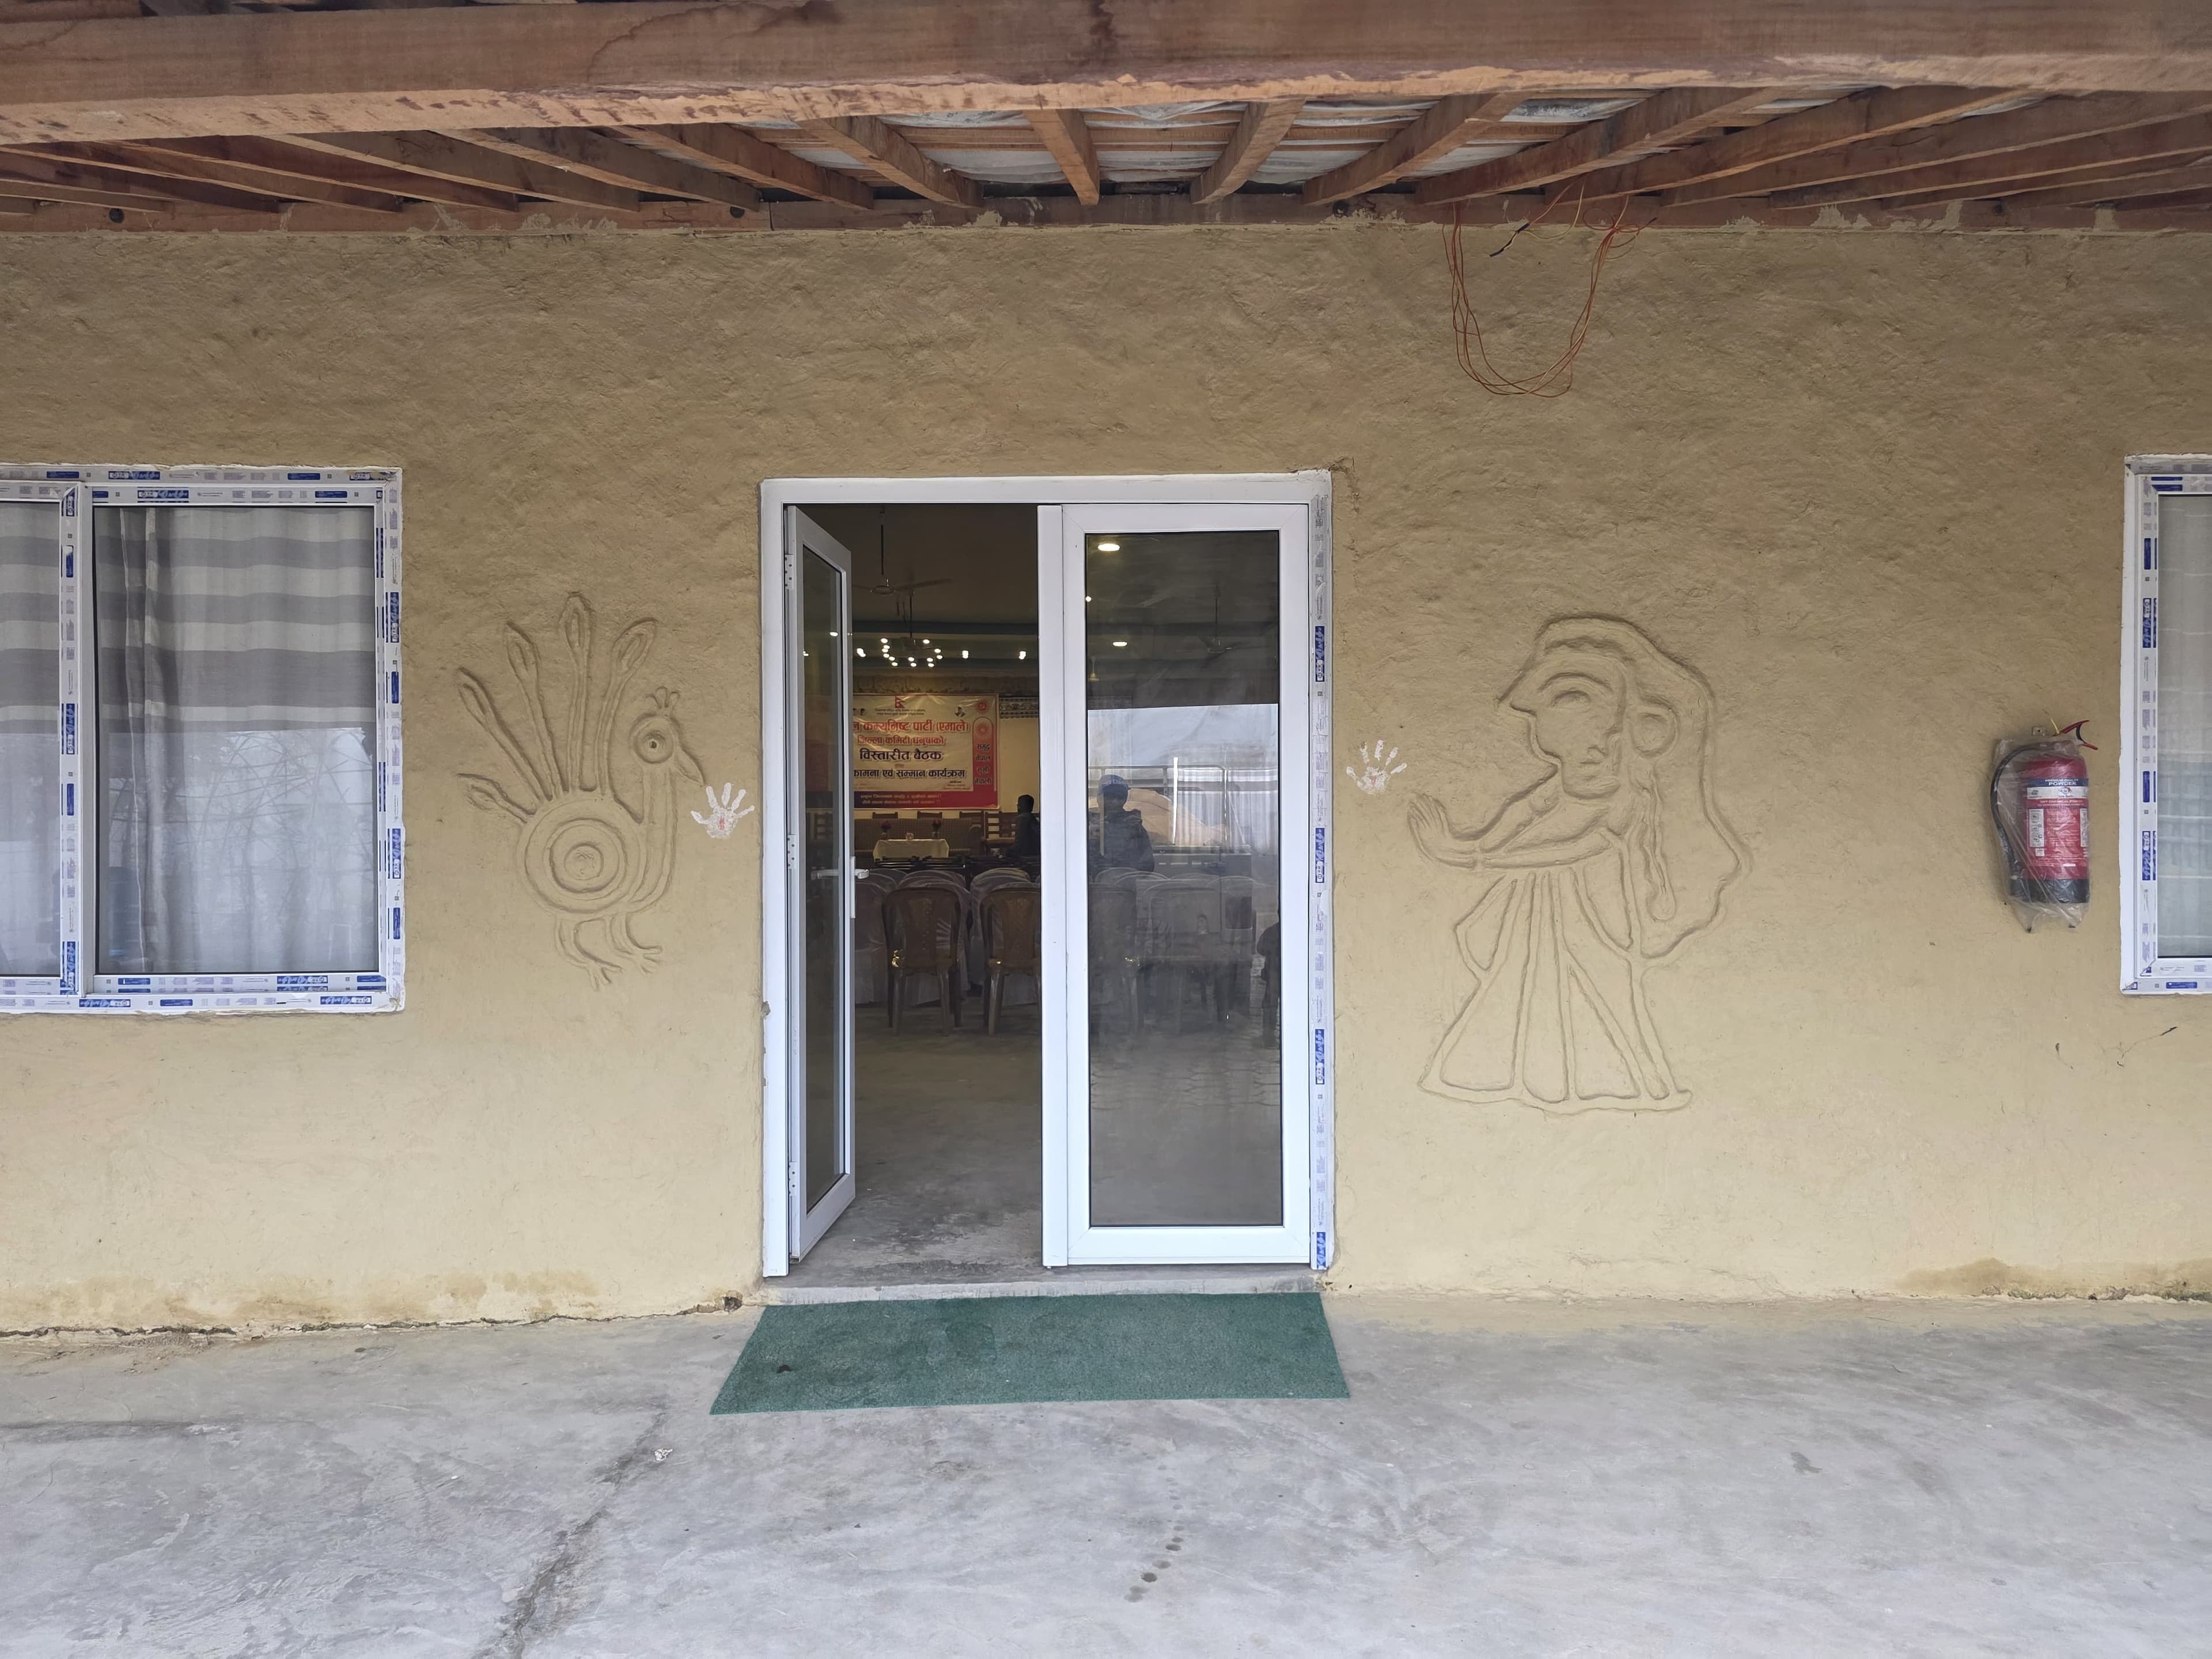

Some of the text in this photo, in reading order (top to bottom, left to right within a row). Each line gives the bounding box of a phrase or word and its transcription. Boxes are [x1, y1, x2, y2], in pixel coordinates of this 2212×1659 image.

[913, 719, 933, 731] पार्टी
[937, 720, 968, 732] (एमाले)
[857, 735, 882, 744] जिल्ला
[885, 735, 910, 744] कमिटी
[859, 748, 942, 760] विस्तारीत बैठक
[882, 768, 893, 777] एवं
[896, 769, 925, 778] सम्मान
[929, 768, 965, 778] कार्यक्रम
